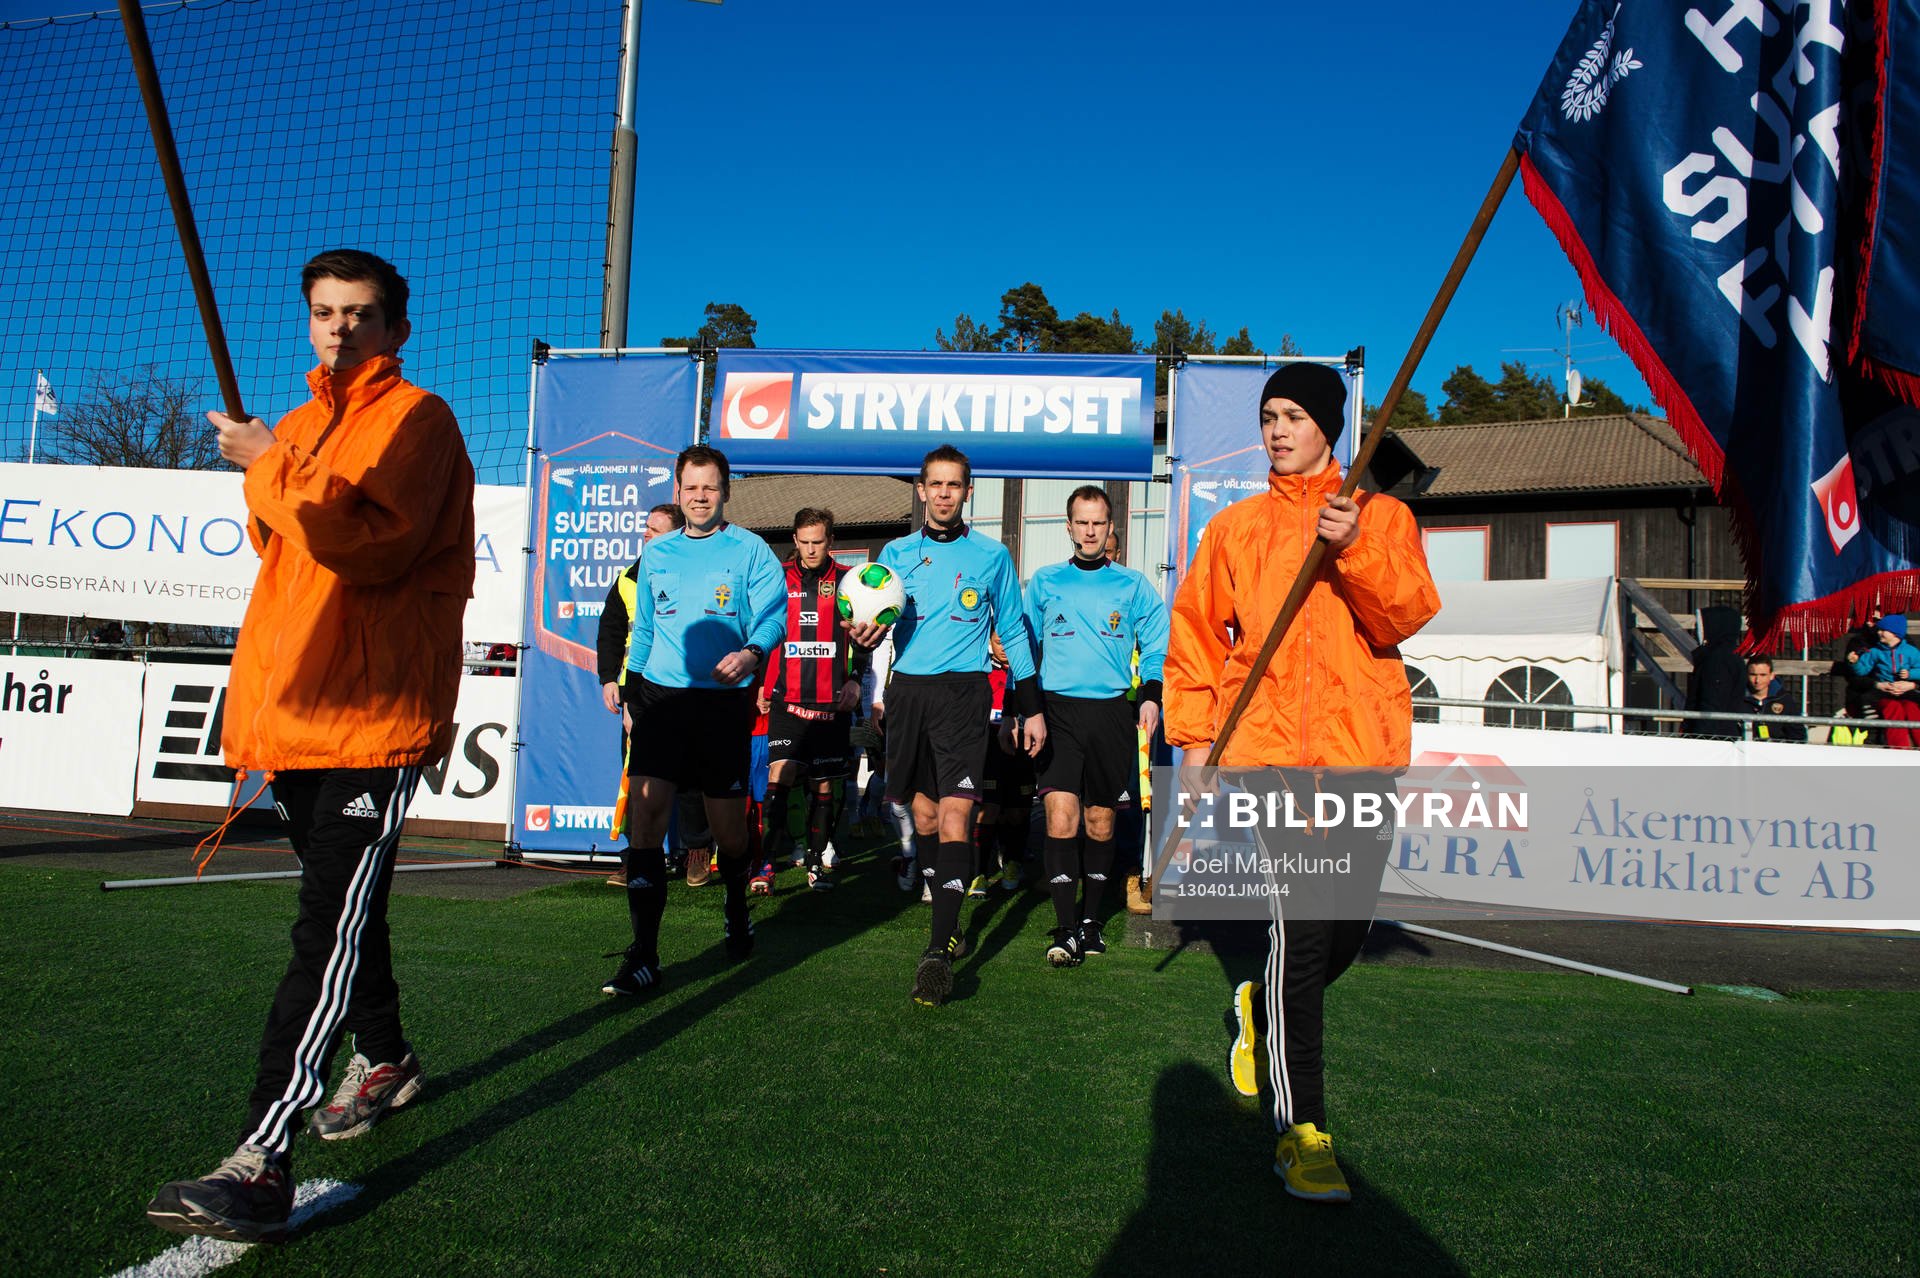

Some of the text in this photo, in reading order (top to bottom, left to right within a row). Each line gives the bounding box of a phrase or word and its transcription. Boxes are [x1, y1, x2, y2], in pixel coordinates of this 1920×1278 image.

[807, 382, 1130, 434] STRYKTIPSET
[581, 484, 639, 506] HELA
[788, 643, 830, 657] Dustin
[342, 807, 380, 819] adidas
[1570, 787, 1879, 858] Åkermyntan
[1569, 846, 1876, 900] Mäklare AB
